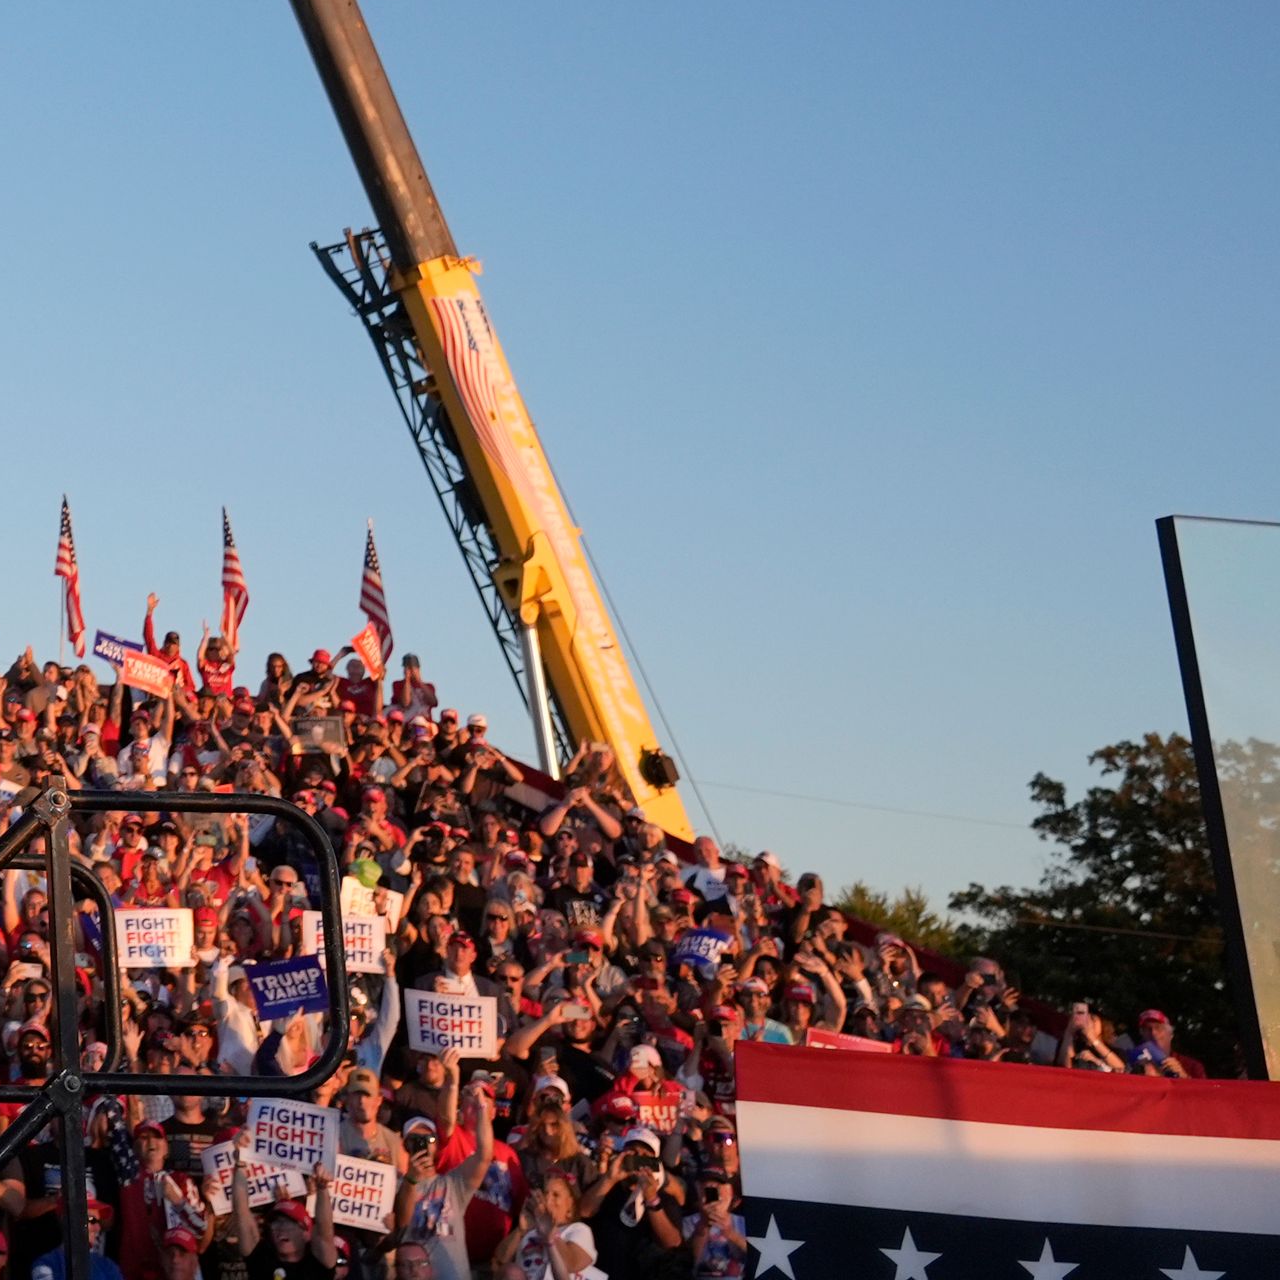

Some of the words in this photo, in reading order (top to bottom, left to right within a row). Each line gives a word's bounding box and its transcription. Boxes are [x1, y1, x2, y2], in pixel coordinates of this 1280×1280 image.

[316, 920, 372, 935] FHT!
[316, 934, 372, 949] FHT!
[317, 947, 372, 963] FHT!
[252, 967, 321, 992] TRUMP
[263, 983, 319, 1001] VANCE
[418, 999, 482, 1018] FIGHT!
[419, 1015, 482, 1033] FIGHT!
[420, 1030, 482, 1048] FIGHT!
[258, 1106, 325, 1131] FIGHT!
[256, 1122, 324, 1148] FIGHT!
[255, 1139, 323, 1163] FIGHT!
[336, 1165, 384, 1187] IGHT!
[224, 1173, 289, 1201] FGHT!
[331, 1200, 381, 1220] IGHT!
